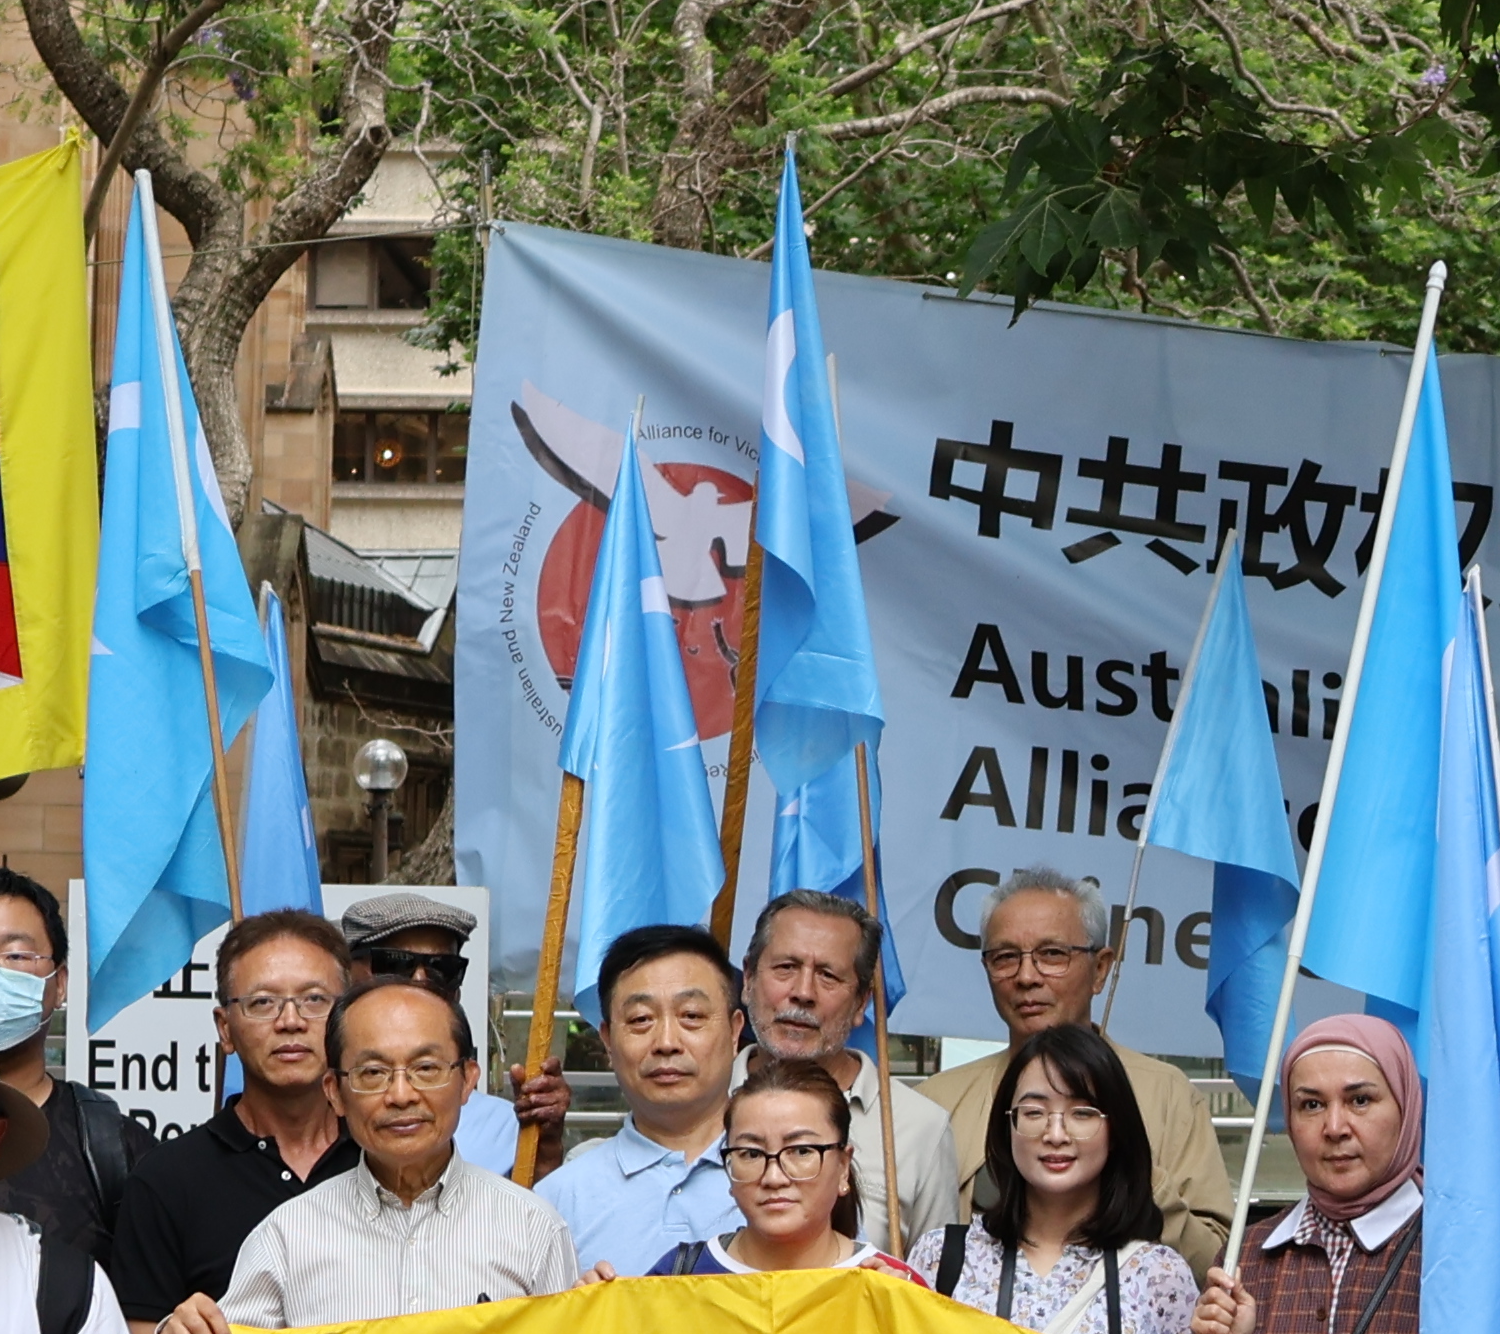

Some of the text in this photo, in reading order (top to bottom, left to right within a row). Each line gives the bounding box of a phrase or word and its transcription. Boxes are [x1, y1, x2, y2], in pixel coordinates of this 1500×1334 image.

[708, 425, 730, 446] for
[502, 501, 542, 578] Zealand
[500, 581, 515, 624] New
[502, 629, 524, 664] and
[517, 667, 563, 736] ustralian
[88, 1039, 178, 1092] End
